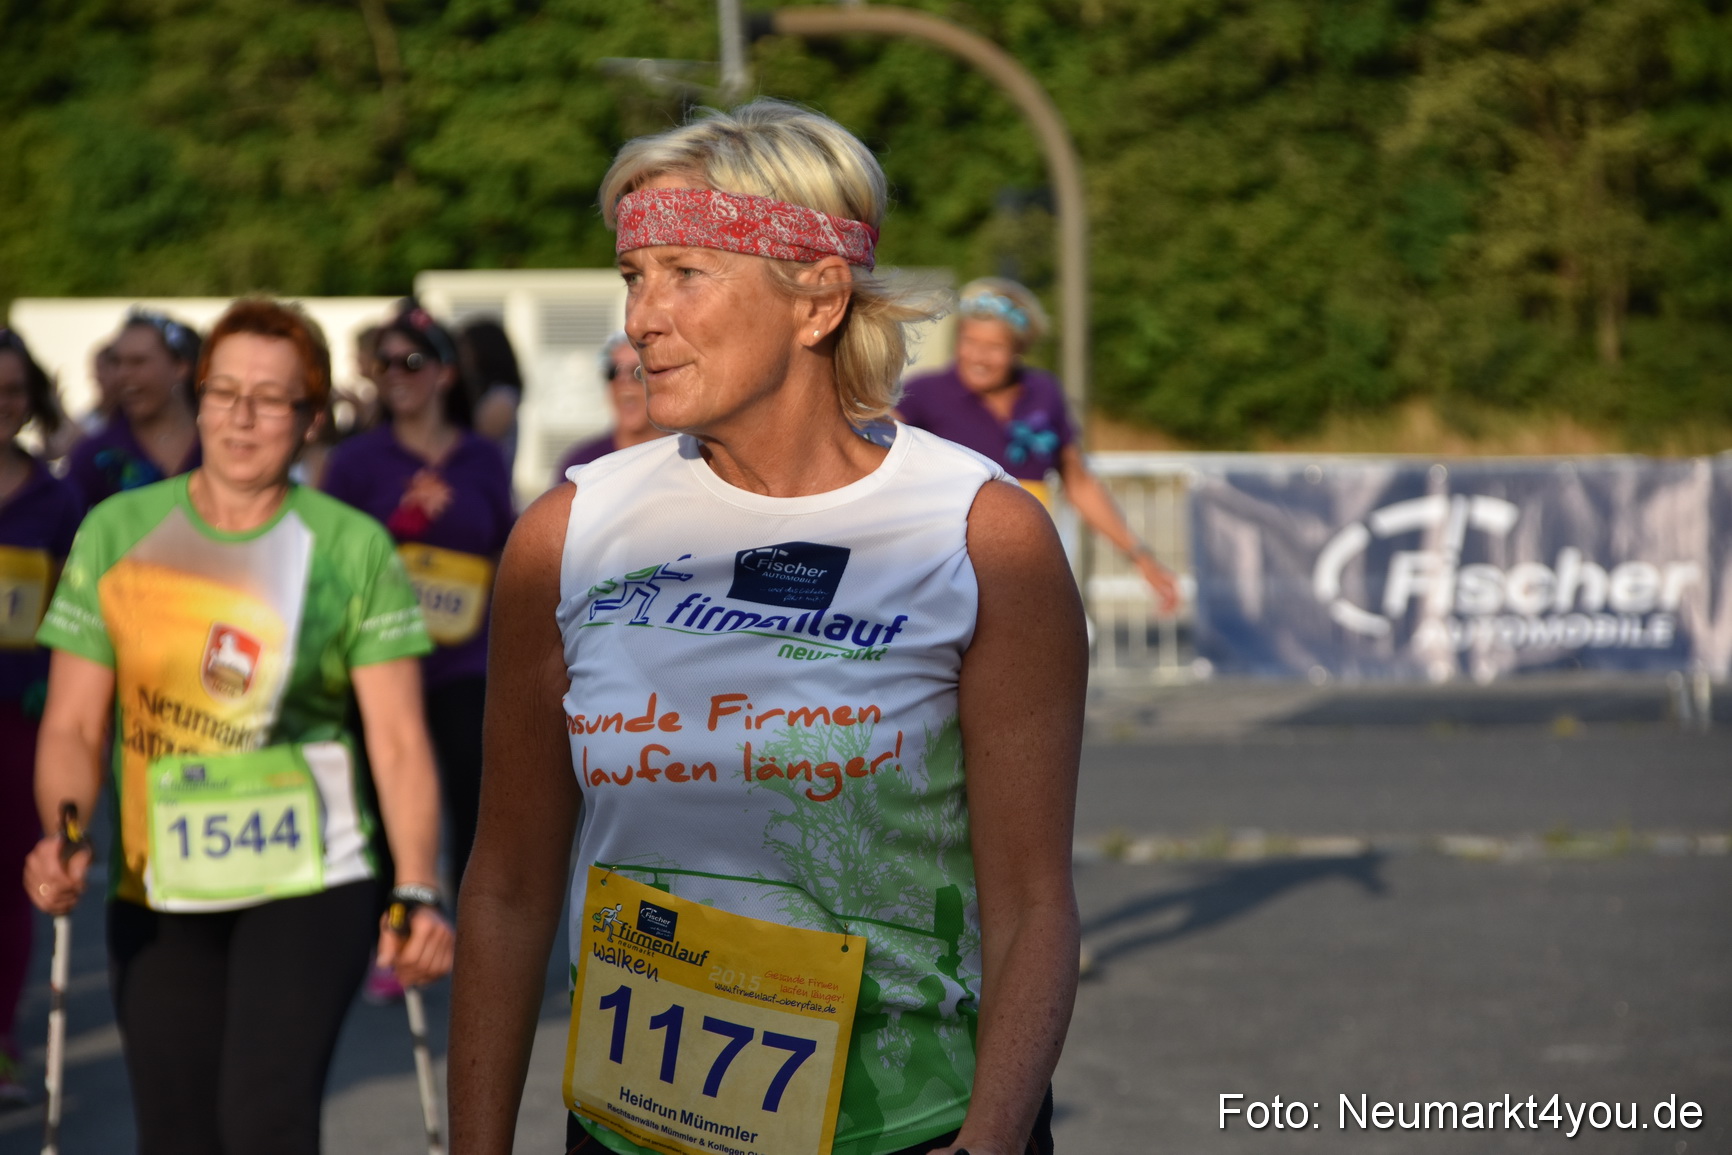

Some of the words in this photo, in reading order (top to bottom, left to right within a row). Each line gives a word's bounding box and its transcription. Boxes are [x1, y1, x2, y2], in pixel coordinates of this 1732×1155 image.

[757, 558, 828, 578] Fischer
[762, 571, 819, 585] AUTOMOBILE
[1383, 544, 1702, 620] Fischer
[1414, 612, 1676, 650] AUTOMOBILE
[707, 692, 881, 732] Firmen
[582, 743, 718, 788] laufen
[743, 730, 904, 802] länger!
[167, 805, 301, 861] 1544
[645, 911, 672, 926] Fischer
[593, 941, 659, 983] walken
[617, 939, 656, 958] neumarkt
[619, 921, 711, 967] firmenlauf
[707, 965, 761, 992] 2015
[714, 982, 837, 1014] www.firmenlauf-oberpfalz.de
[764, 970, 805, 985] Gesunde
[808, 978, 840, 991] Firmen
[780, 984, 808, 998] laufen
[810, 988, 846, 1004] länger!
[599, 984, 818, 1113] 1177
[607, 1102, 660, 1131] Rechtsanwälte
[660, 1124, 698, 1144] Mümmler
[699, 1138, 706, 1147] &
[707, 1140, 746, 1155] Kollegen
[619, 1086, 678, 1121] Heidrun
[679, 1109, 759, 1144] Mümmler
